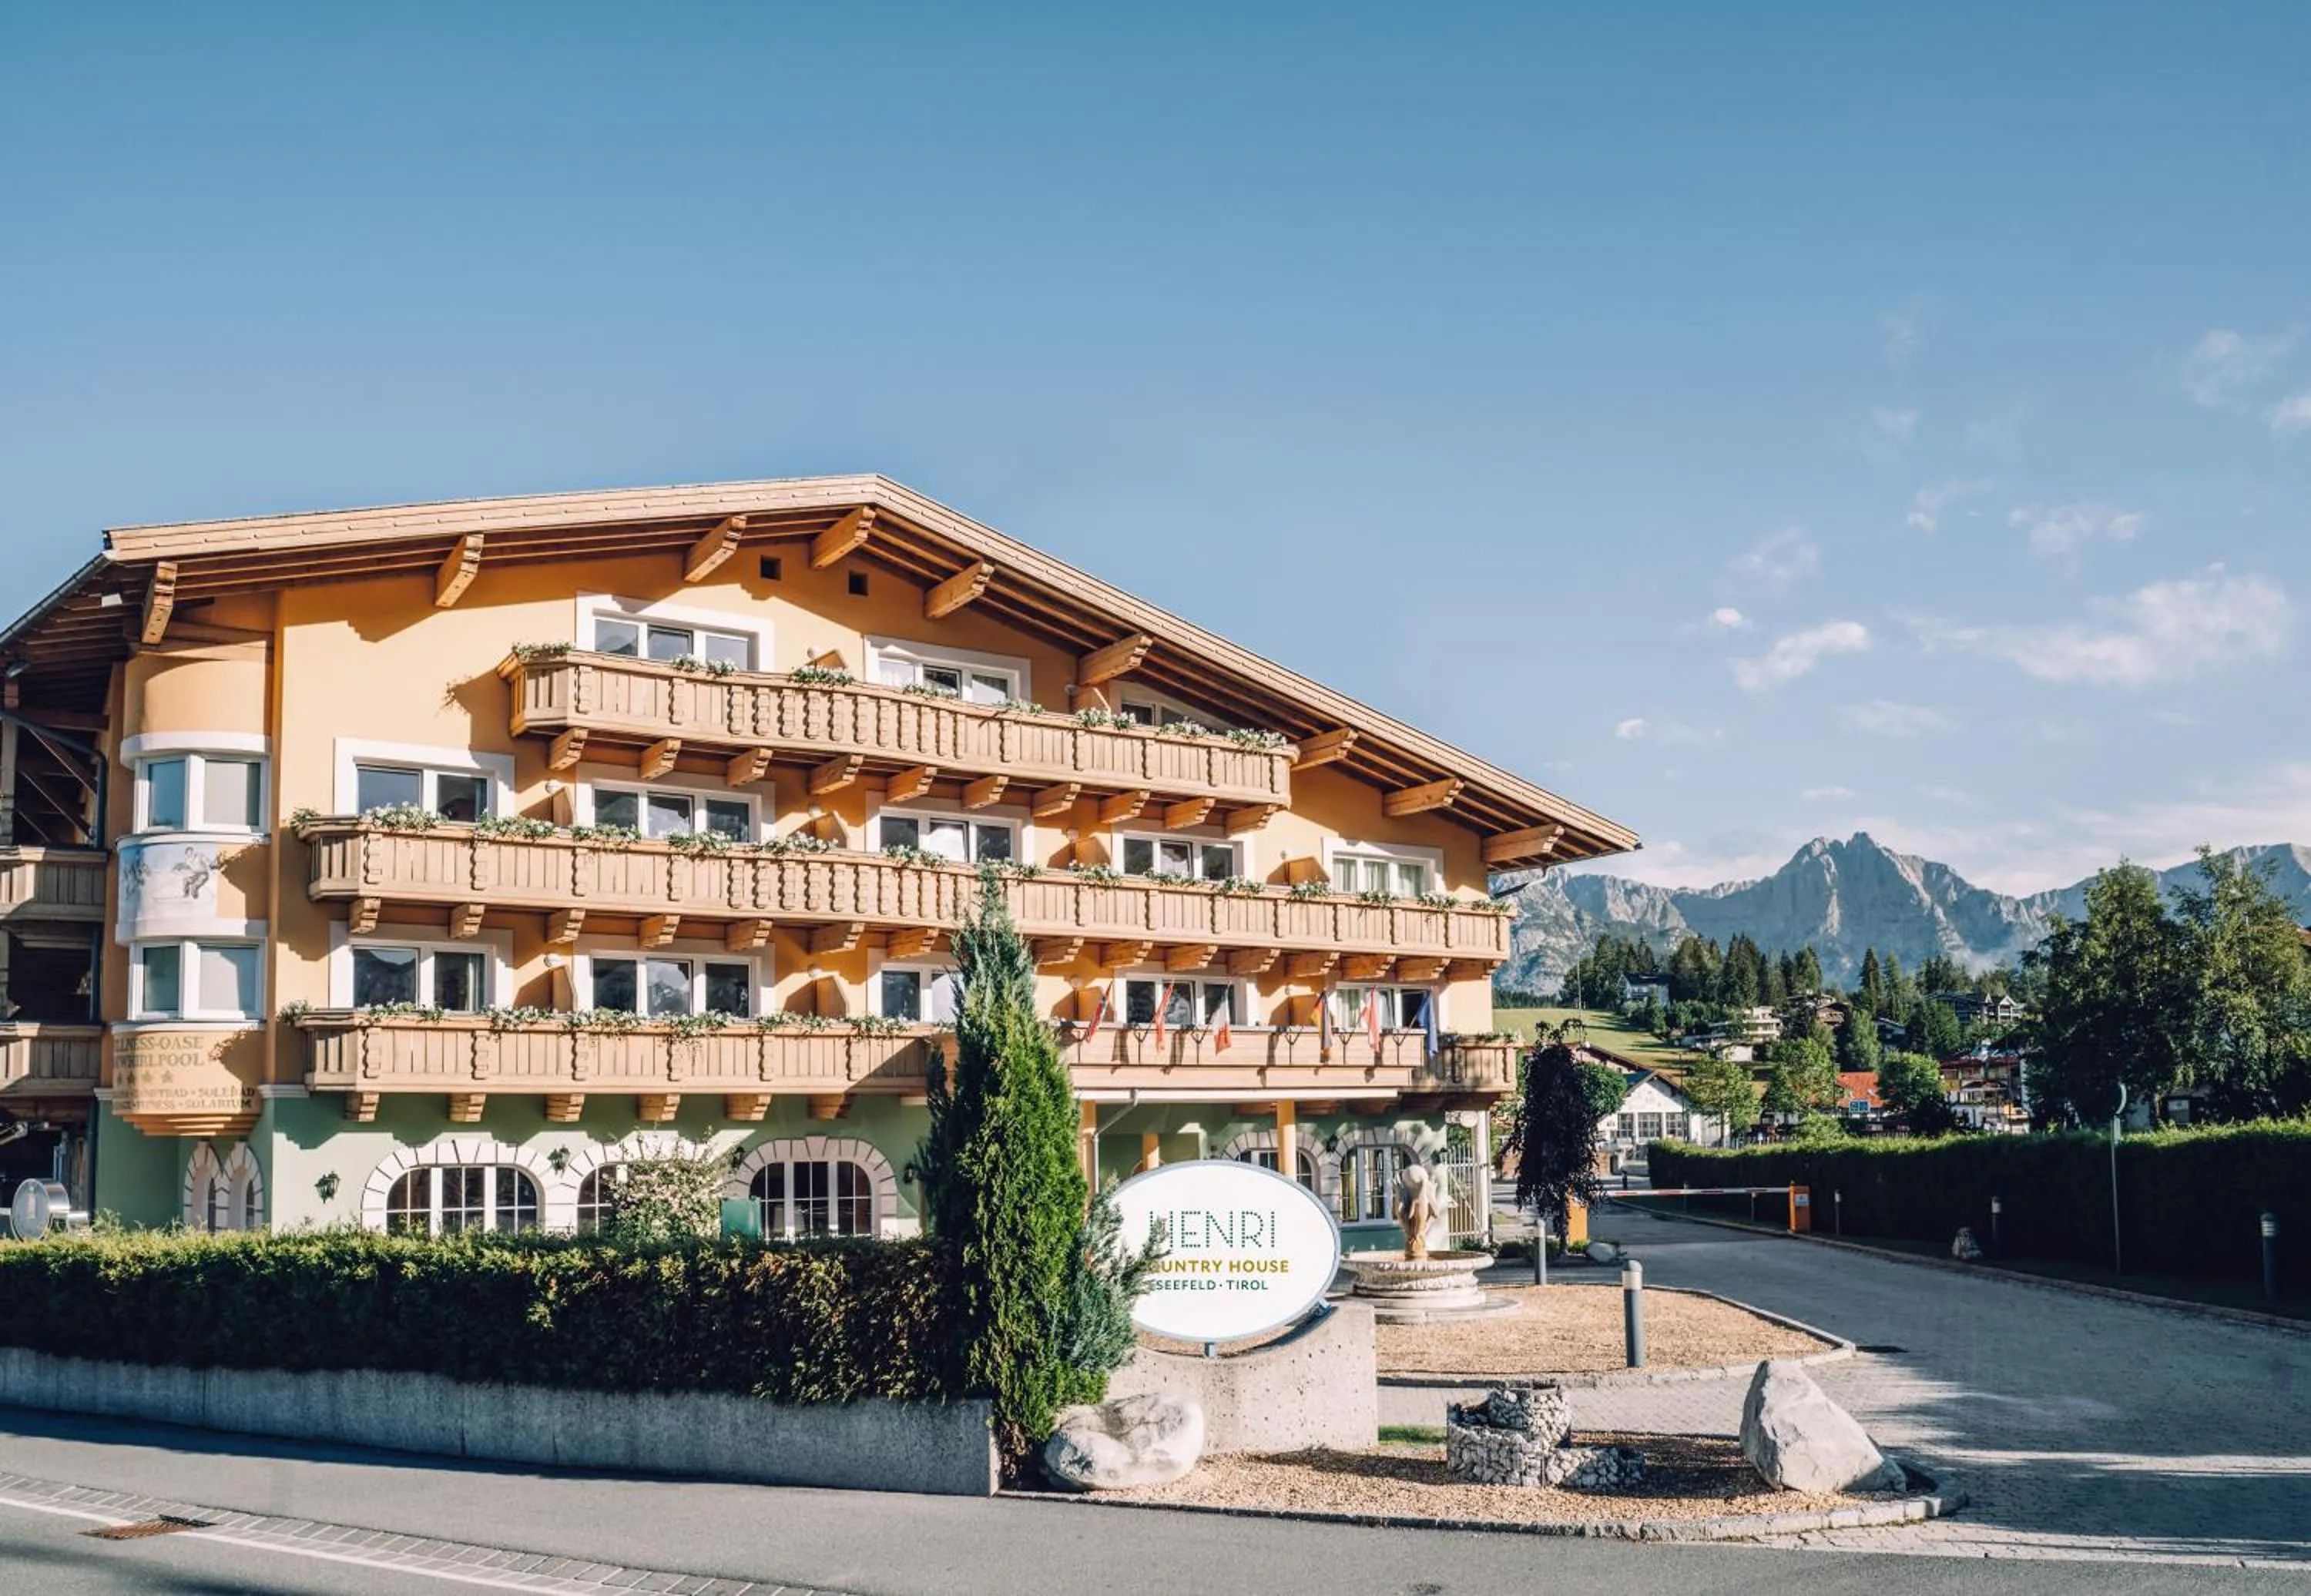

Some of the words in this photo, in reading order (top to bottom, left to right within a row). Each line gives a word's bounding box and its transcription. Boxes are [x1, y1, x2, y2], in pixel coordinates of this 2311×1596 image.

[1149, 1210, 1276, 1248] HENRI
[1136, 1259, 1223, 1273] OUNTRY
[1229, 1259, 1289, 1273] HOUSE
[1156, 1279, 1217, 1291] SEEFELD
[1226, 1279, 1269, 1290] TIROL
